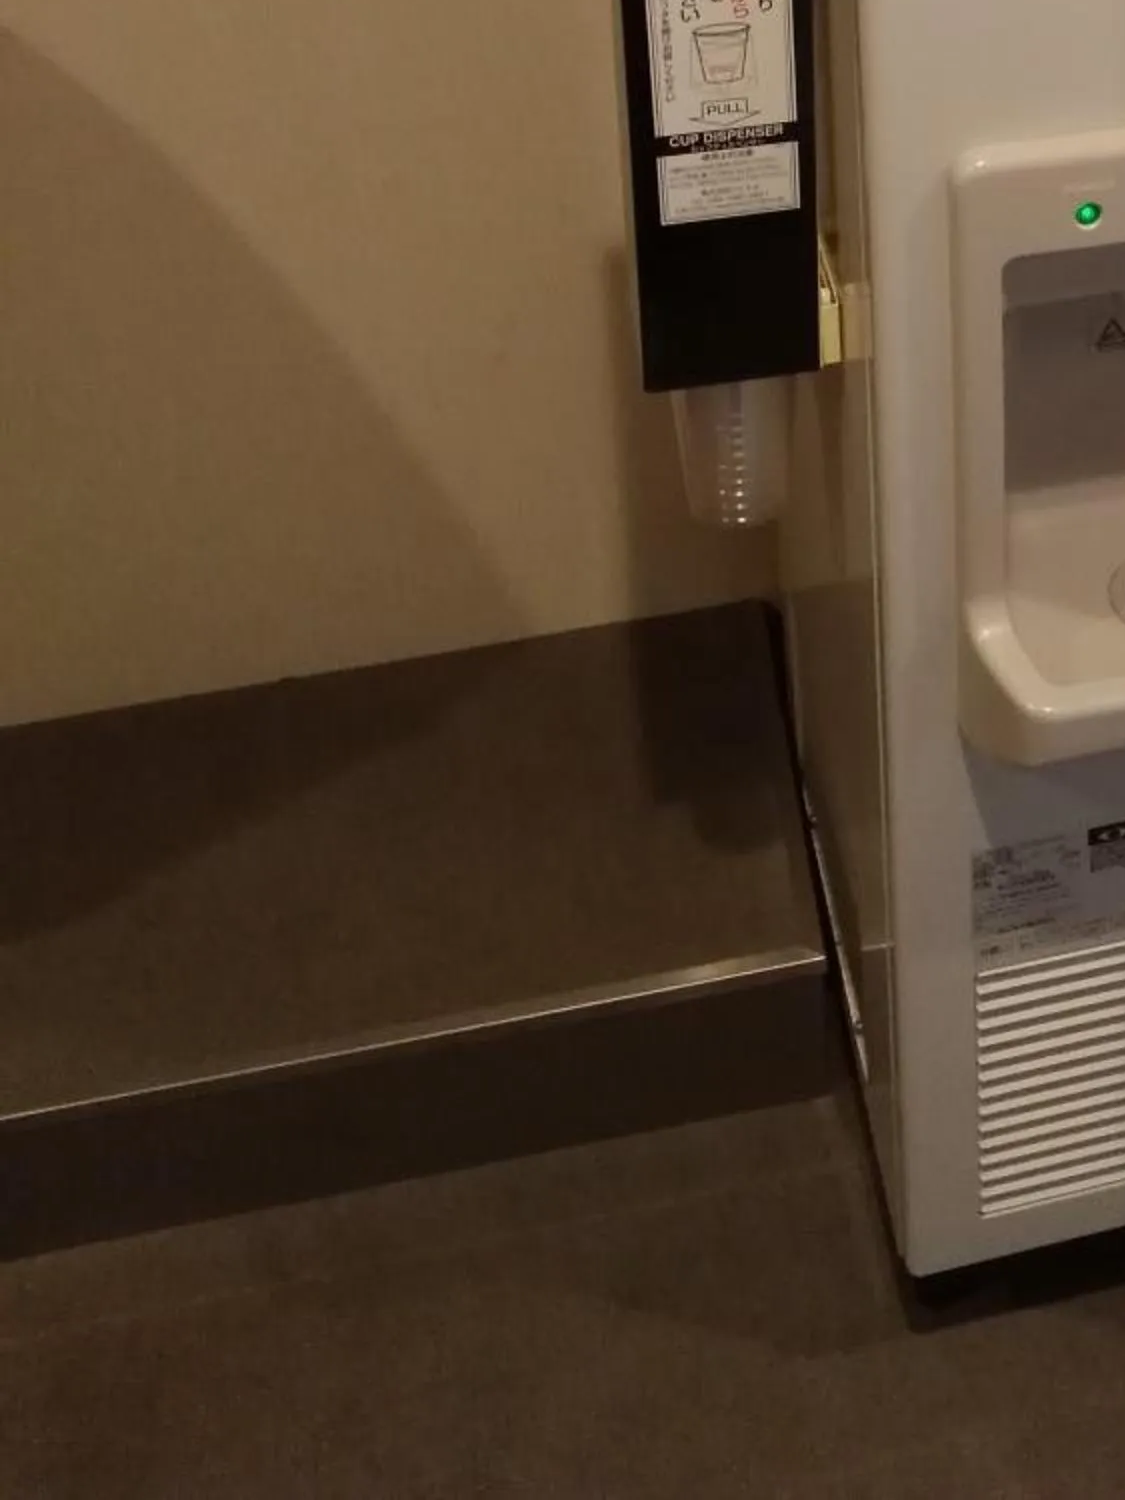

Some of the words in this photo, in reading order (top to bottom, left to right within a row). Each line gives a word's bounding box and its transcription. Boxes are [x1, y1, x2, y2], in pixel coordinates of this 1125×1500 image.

[706, 102, 745, 116] PULL
[669, 133, 699, 148] CUP
[703, 123, 785, 143] DISPENSER
